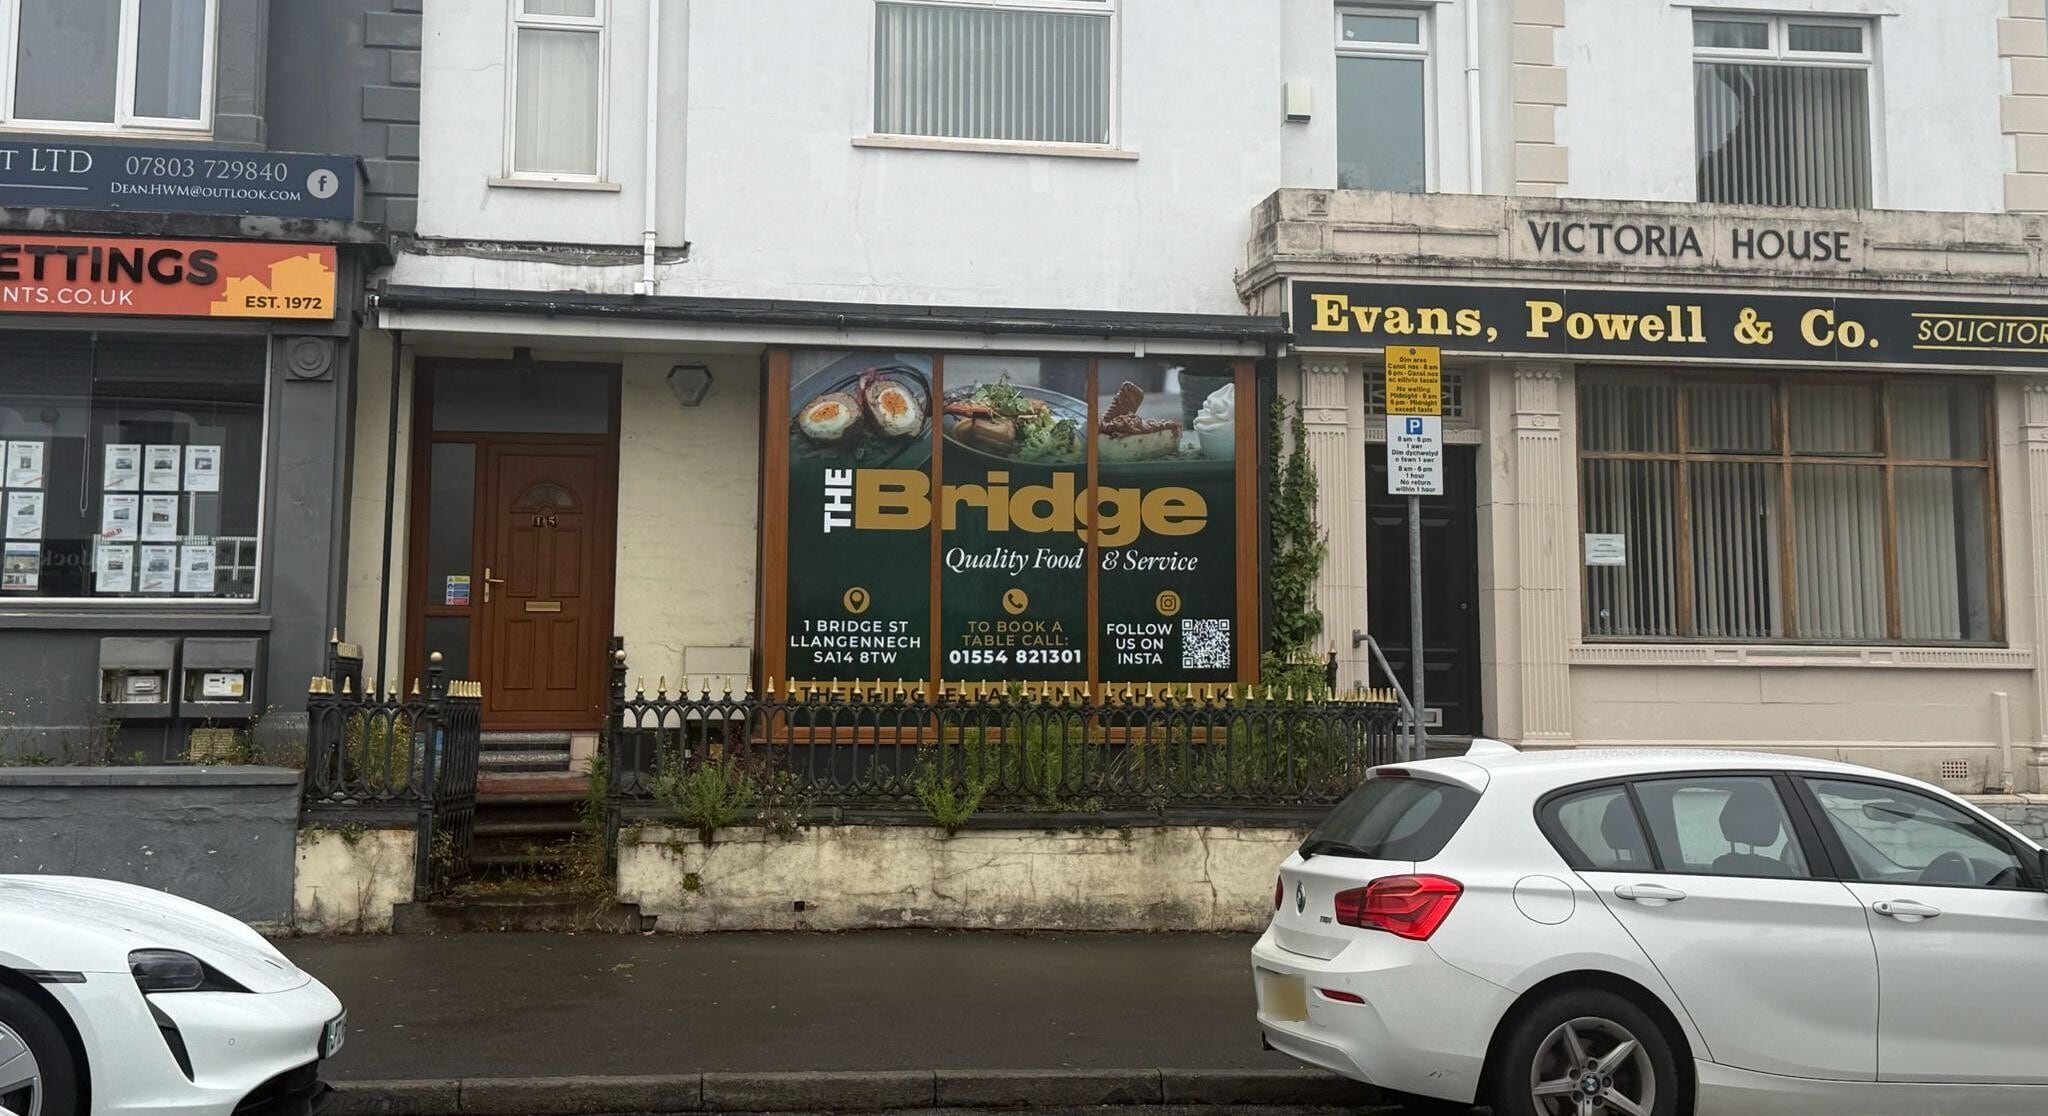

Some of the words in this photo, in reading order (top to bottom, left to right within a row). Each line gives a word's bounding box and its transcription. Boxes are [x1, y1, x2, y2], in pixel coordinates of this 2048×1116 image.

[30, 148, 93, 173] LTD
[126, 155, 194, 178] 07803
[204, 159, 288, 182] 729840
[1528, 220, 1703, 257] VICTORIA
[1732, 228, 1851, 263] HOUSE
[3, 286, 134, 306] NTS.CO.UK
[245, 295, 280, 309] EST.
[284, 296, 322, 310] 1972
[1310, 293, 1498, 343] Evans,
[1525, 300, 1707, 345] Powell
[1733, 306, 1774, 346] &
[1800, 308, 1880, 349] Co.
[1410, 420, 1421, 434] P
[823, 468, 853, 533] THE
[855, 467, 1208, 547] Bridge
[945, 547, 1029, 576] Quality
[1032, 548, 1084, 570] Food
[1101, 550, 1119, 571] &
[1123, 549, 1199, 571] Service
[803, 620, 810, 632] 1
[817, 620, 882, 633] BRIDGE
[888, 621, 909, 633] ST
[968, 621, 990, 632] TO
[996, 621, 1046, 632] BOOK
[1051, 621, 1063, 632] A
[1106, 623, 1173, 635] FOLLOW
[790, 635, 921, 648] LLANGENNECH
[962, 635, 1015, 646] TABLE
[1022, 635, 1070, 646] CALL:
[1115, 638, 1136, 650] US
[1140, 638, 1164, 650] ON
[814, 651, 854, 663] SA14
[860, 651, 897, 663] 8TW
[949, 650, 1008, 664] 01554
[1015, 649, 1081, 664] 821301
[1118, 653, 1163, 665] INSTA
